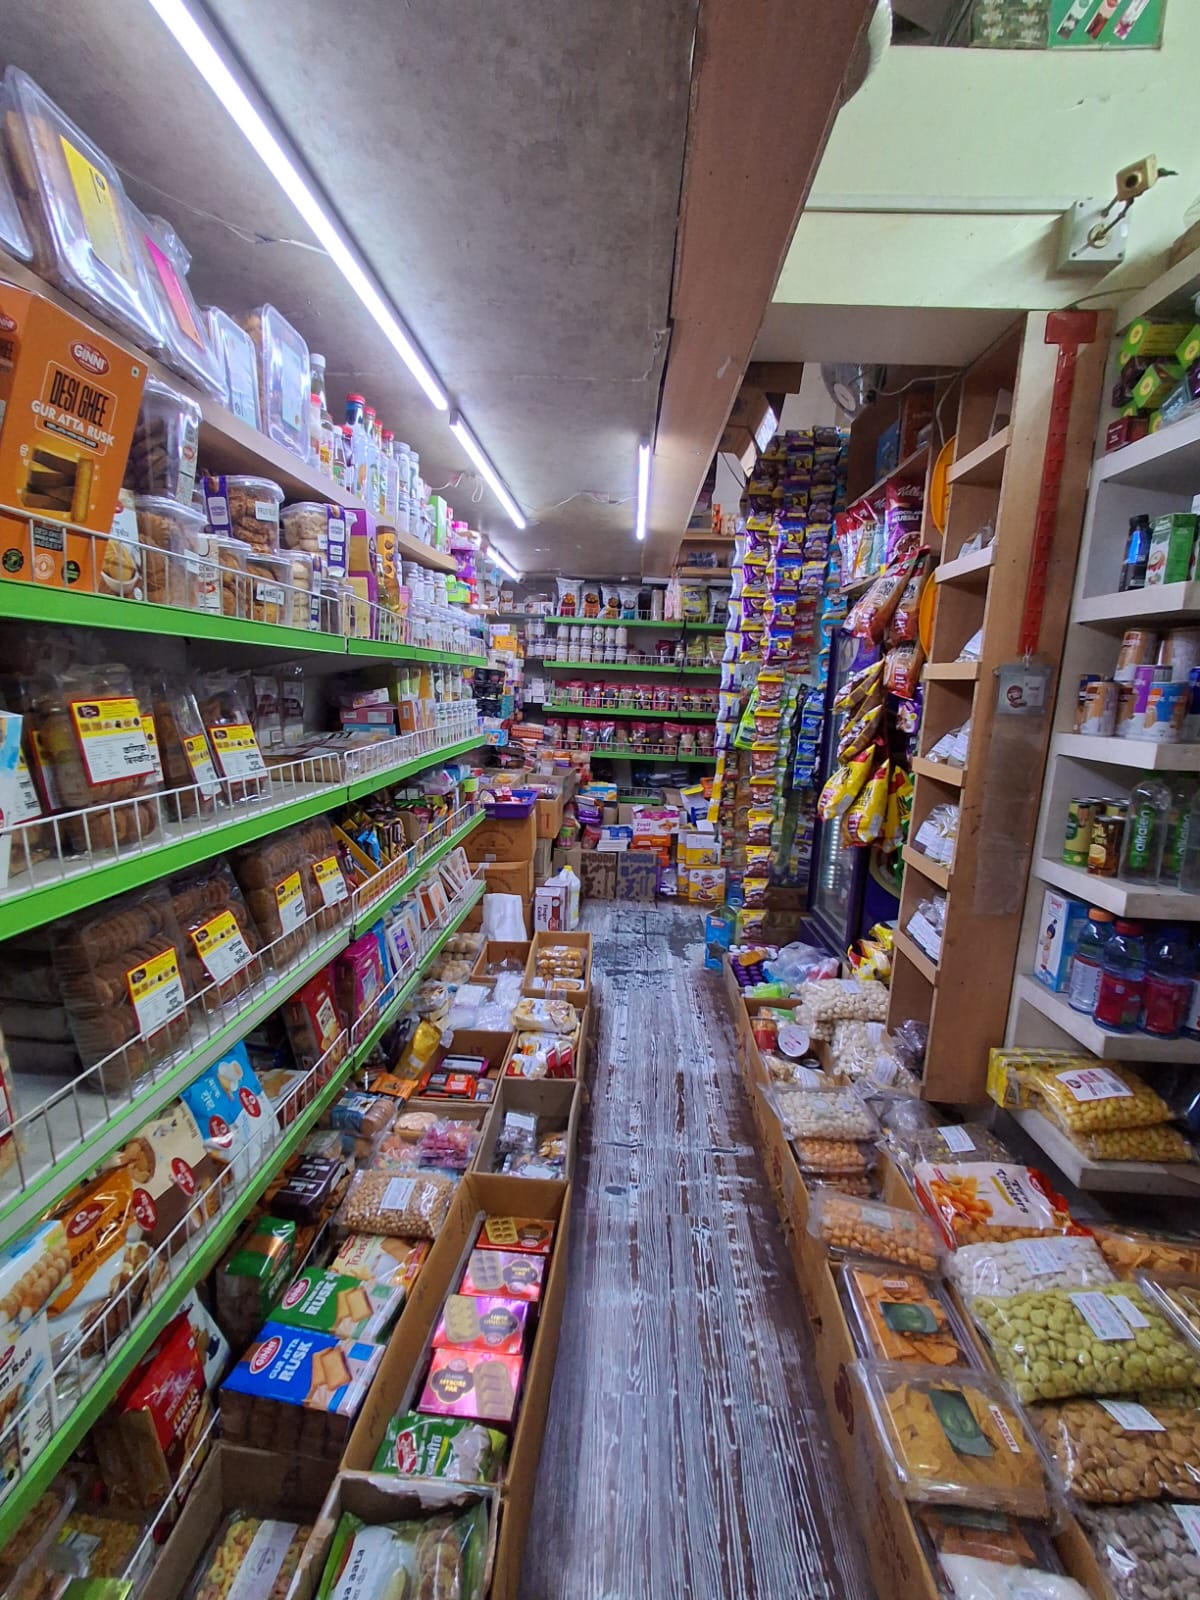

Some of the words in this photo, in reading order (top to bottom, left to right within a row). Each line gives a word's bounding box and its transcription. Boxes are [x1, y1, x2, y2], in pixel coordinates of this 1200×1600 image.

[74, 344, 105, 370] GINNI
[49, 370, 80, 413] DESI
[78, 385, 109, 427] GHEE
[32, 400, 56, 419] GUR
[58, 414, 84, 433] ATTA
[87, 425, 114, 446] RUSK
[305, 1281, 337, 1316] RUSK
[255, 1340, 278, 1367] GINNI
[269, 1360, 285, 1379] GUR
[282, 1338, 300, 1359] ATTA
[278, 1341, 313, 1382] RUSK
